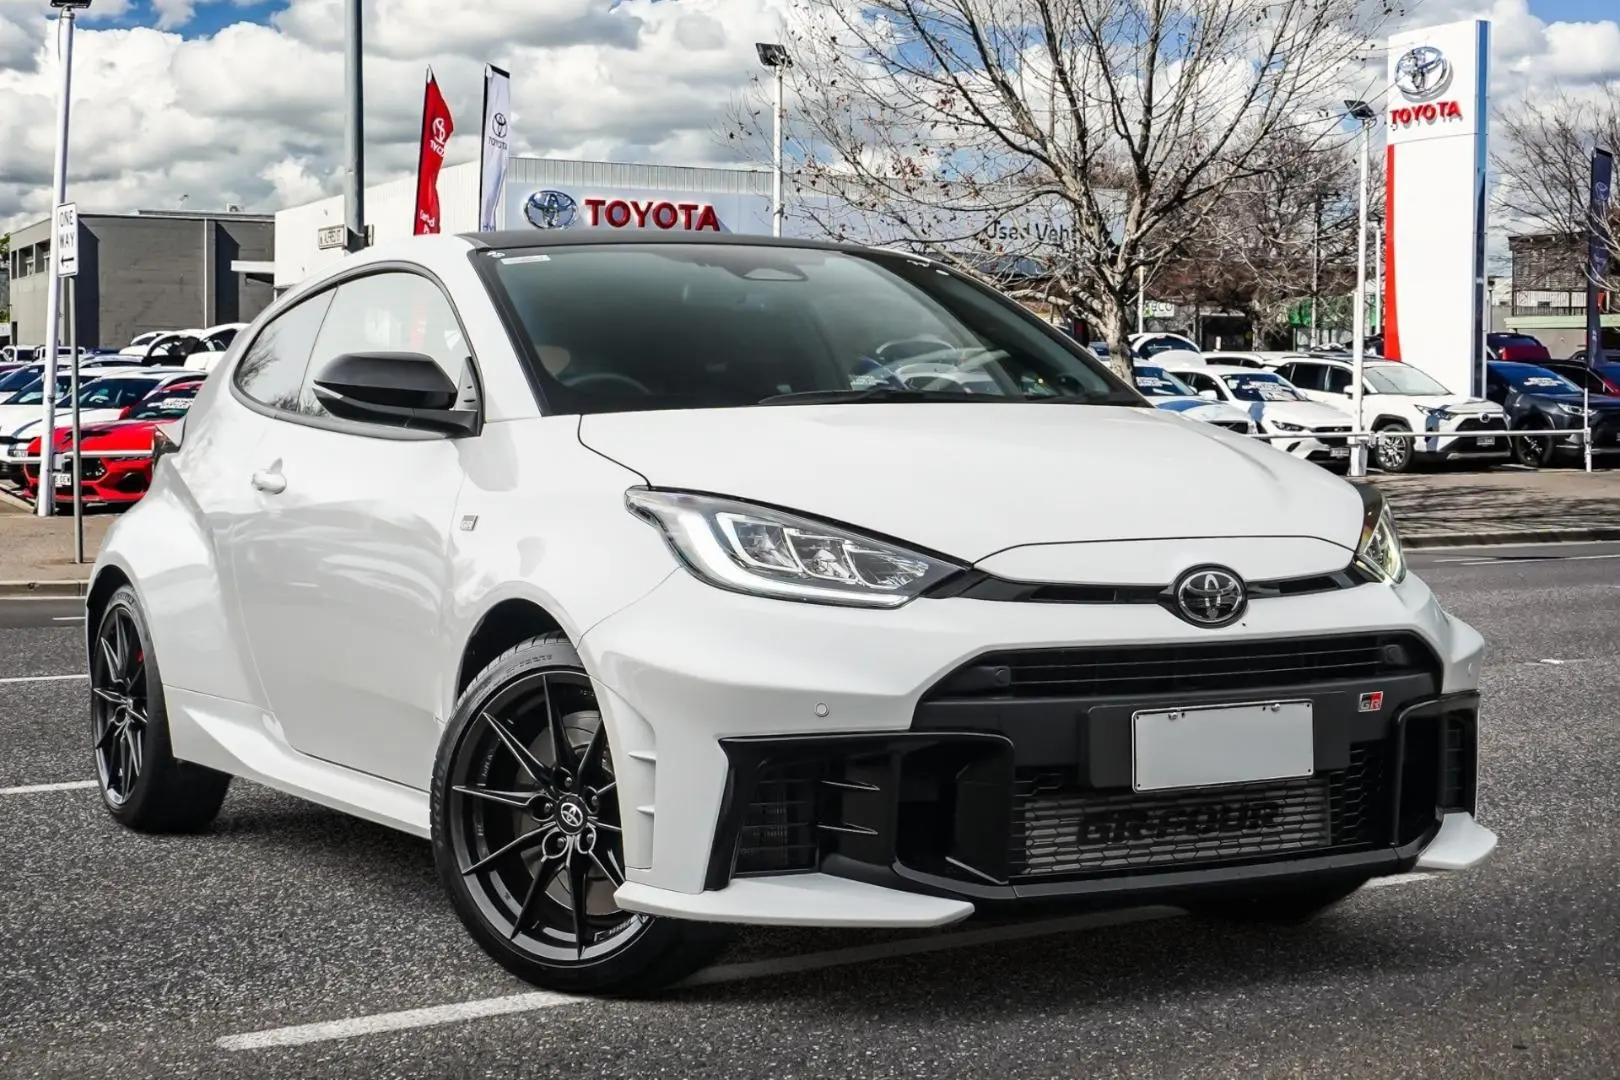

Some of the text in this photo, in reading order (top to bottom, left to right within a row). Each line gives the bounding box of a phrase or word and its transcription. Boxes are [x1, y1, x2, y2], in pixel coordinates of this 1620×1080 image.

[1389, 101, 1462, 124] TOYOTA
[59, 209, 74, 227] ONE
[585, 198, 720, 231] TOYOTA
[59, 231, 74, 249] WAY
